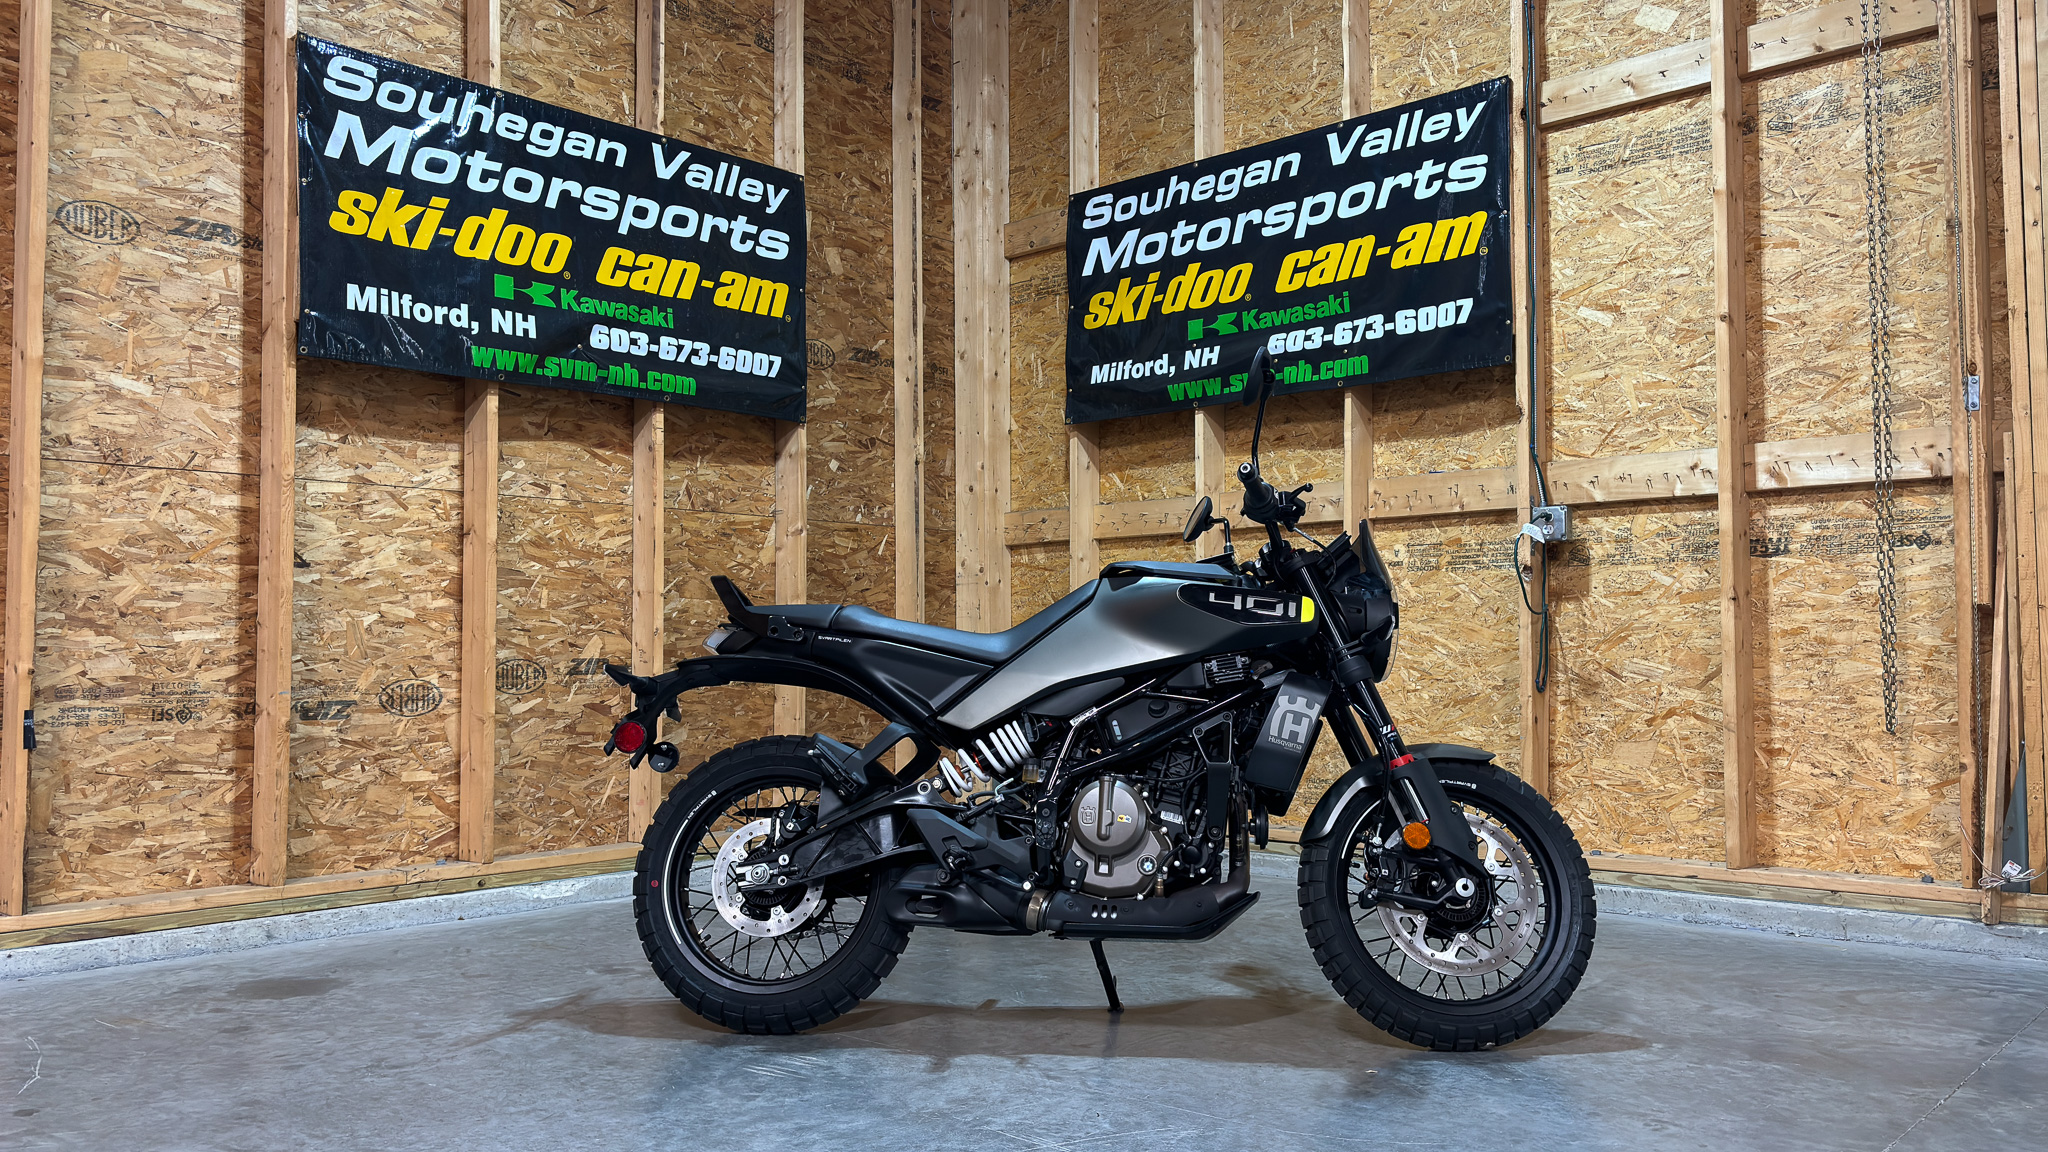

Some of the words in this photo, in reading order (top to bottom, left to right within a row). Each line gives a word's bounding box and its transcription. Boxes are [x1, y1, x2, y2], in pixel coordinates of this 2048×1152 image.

[323, 54, 628, 168] Souhegan
[651, 142, 790, 214] Valley
[324, 109, 791, 260] Motorsports
[1082, 152, 1301, 230] Souhegan
[1326, 100, 1487, 166] Valley
[1081, 153, 1489, 277] Motorsports
[345, 283, 481, 335] Milford,
[491, 307, 538, 339] NH
[560, 287, 675, 329] Kawasaki
[1242, 291, 1351, 332] Kawasaki
[1267, 297, 1474, 355] 603-673-6007
[470, 345, 697, 396] www.svm-nh.com
[588, 323, 783, 378] 603-673-6007
[1089, 353, 1176, 384] Milford,
[1183, 345, 1221, 370] NH
[1208, 591, 1298, 618] 401
[1267, 735, 1303, 751] Husqvarna
